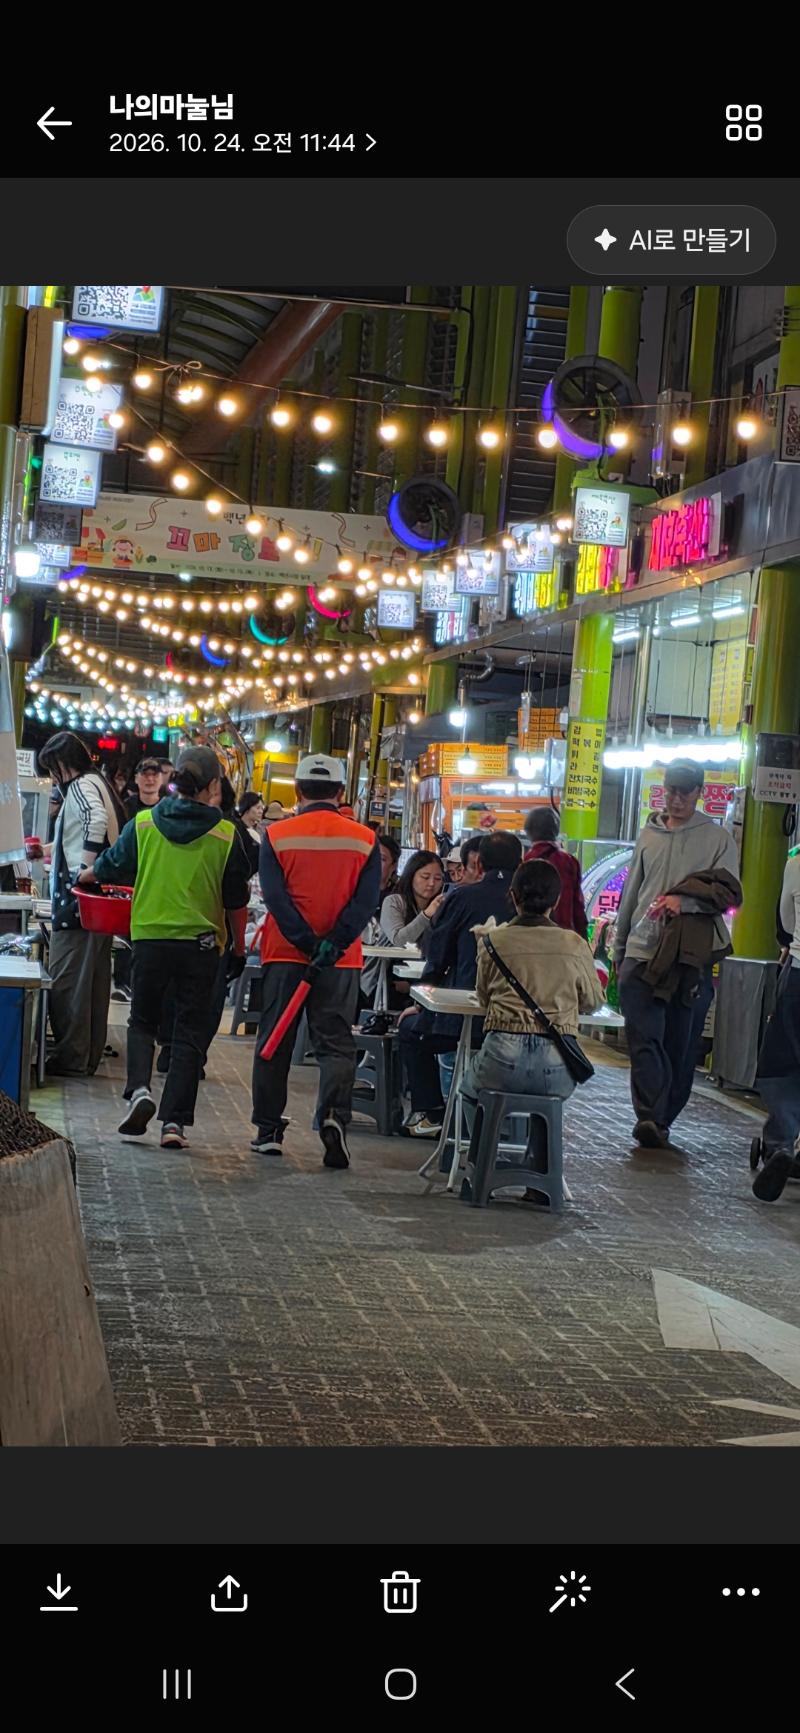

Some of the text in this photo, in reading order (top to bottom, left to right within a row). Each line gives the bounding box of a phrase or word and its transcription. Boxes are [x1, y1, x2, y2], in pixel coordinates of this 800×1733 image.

[166, 525, 221, 553] 꼬마
[568, 774, 598, 785] 잔치국수
[567, 786, 597, 798] 비빔국수
